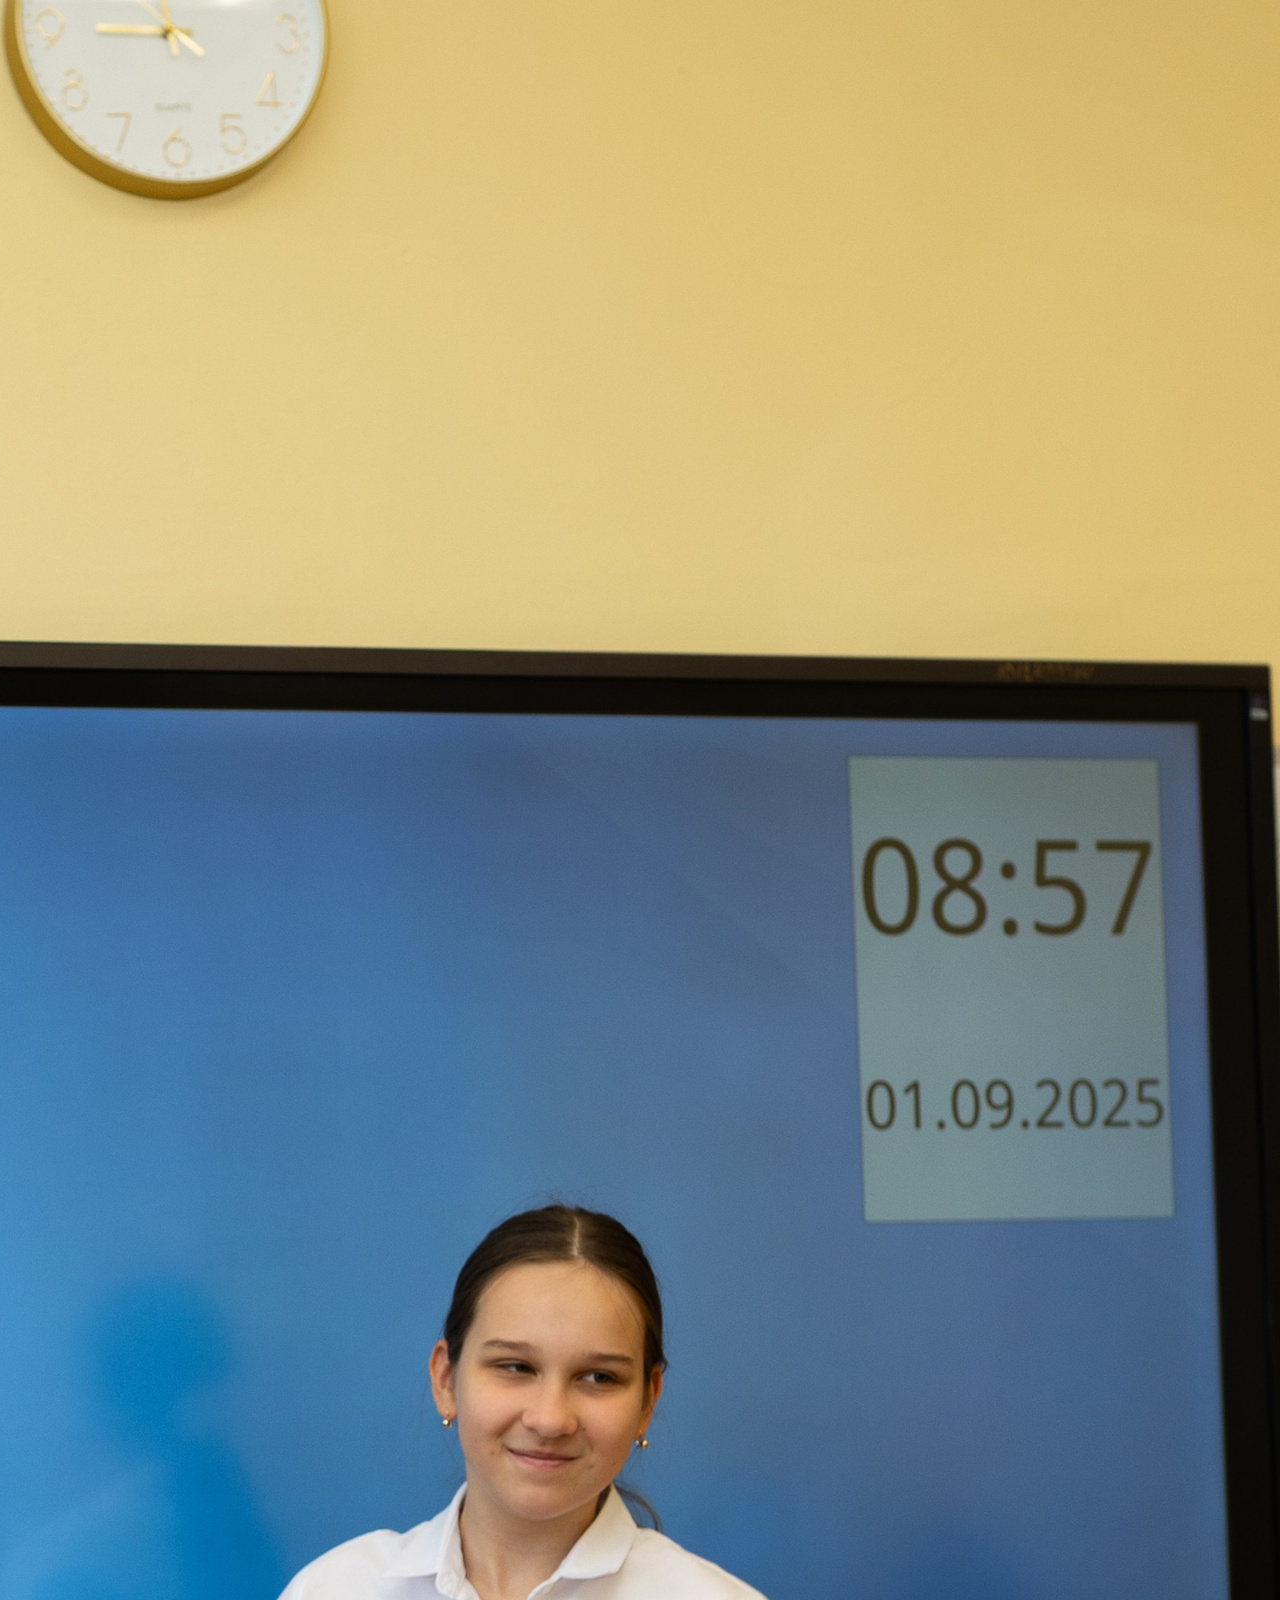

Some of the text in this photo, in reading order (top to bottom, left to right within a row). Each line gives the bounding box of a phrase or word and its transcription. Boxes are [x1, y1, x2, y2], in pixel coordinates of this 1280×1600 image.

[35, 8, 65, 51] 9
[274, 12, 301, 55] 3
[60, 68, 88, 111] 8
[256, 71, 281, 107] 4
[106, 112, 132, 151] 7
[162, 127, 192, 168] 6
[220, 114, 247, 156] 5
[861, 838, 1152, 936] 08:57
[866, 1078, 1165, 1132] 01.09.2025
